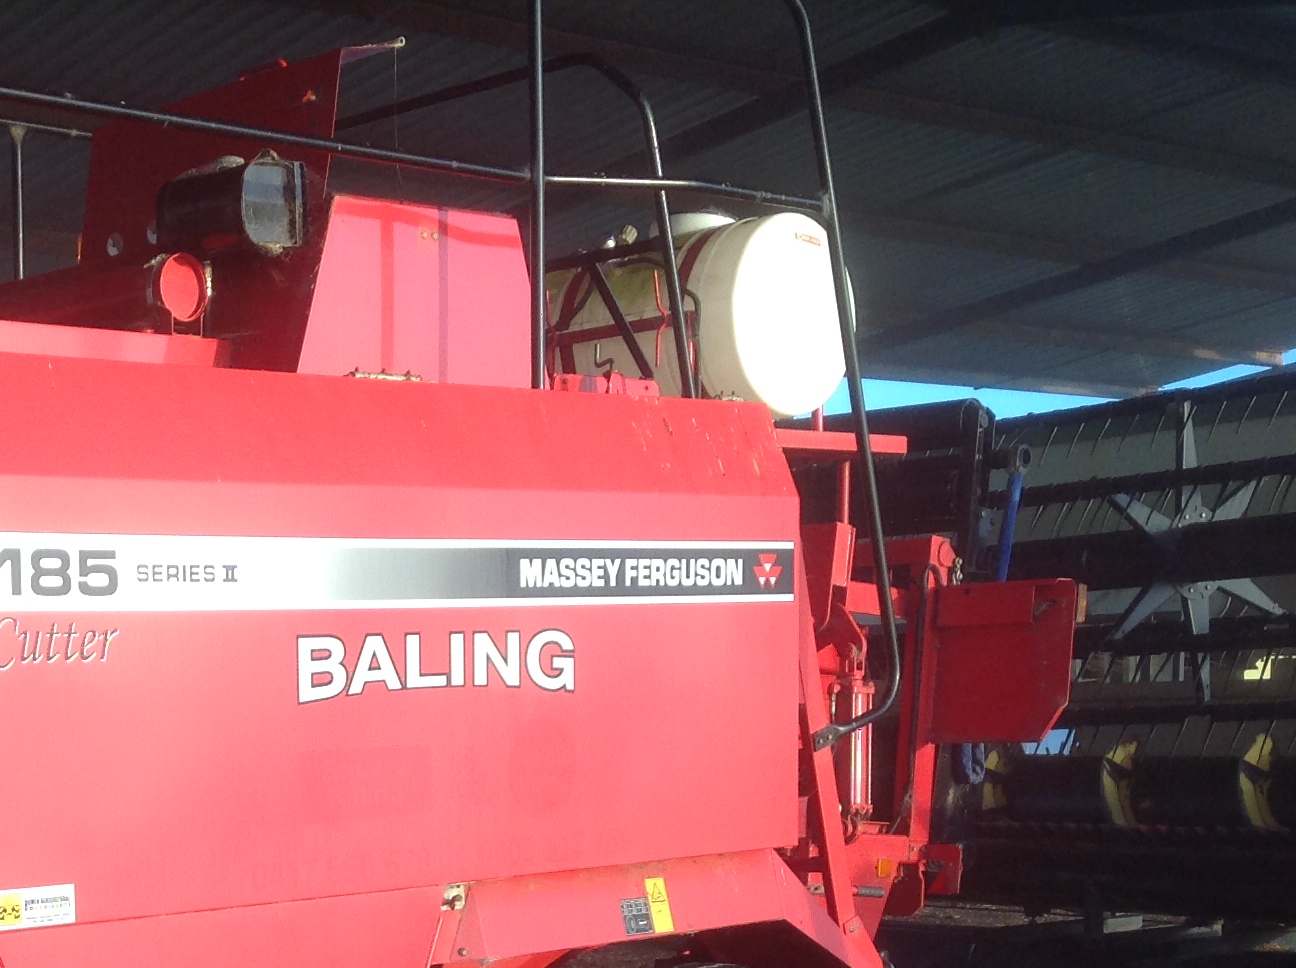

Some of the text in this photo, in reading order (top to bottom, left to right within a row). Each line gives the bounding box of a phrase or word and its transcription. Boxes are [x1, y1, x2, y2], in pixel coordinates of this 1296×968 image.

[136, 564, 216, 583] SERIES
[519, 557, 744, 588] MASSEY FERGUSON
[297, 628, 576, 704] BALING
